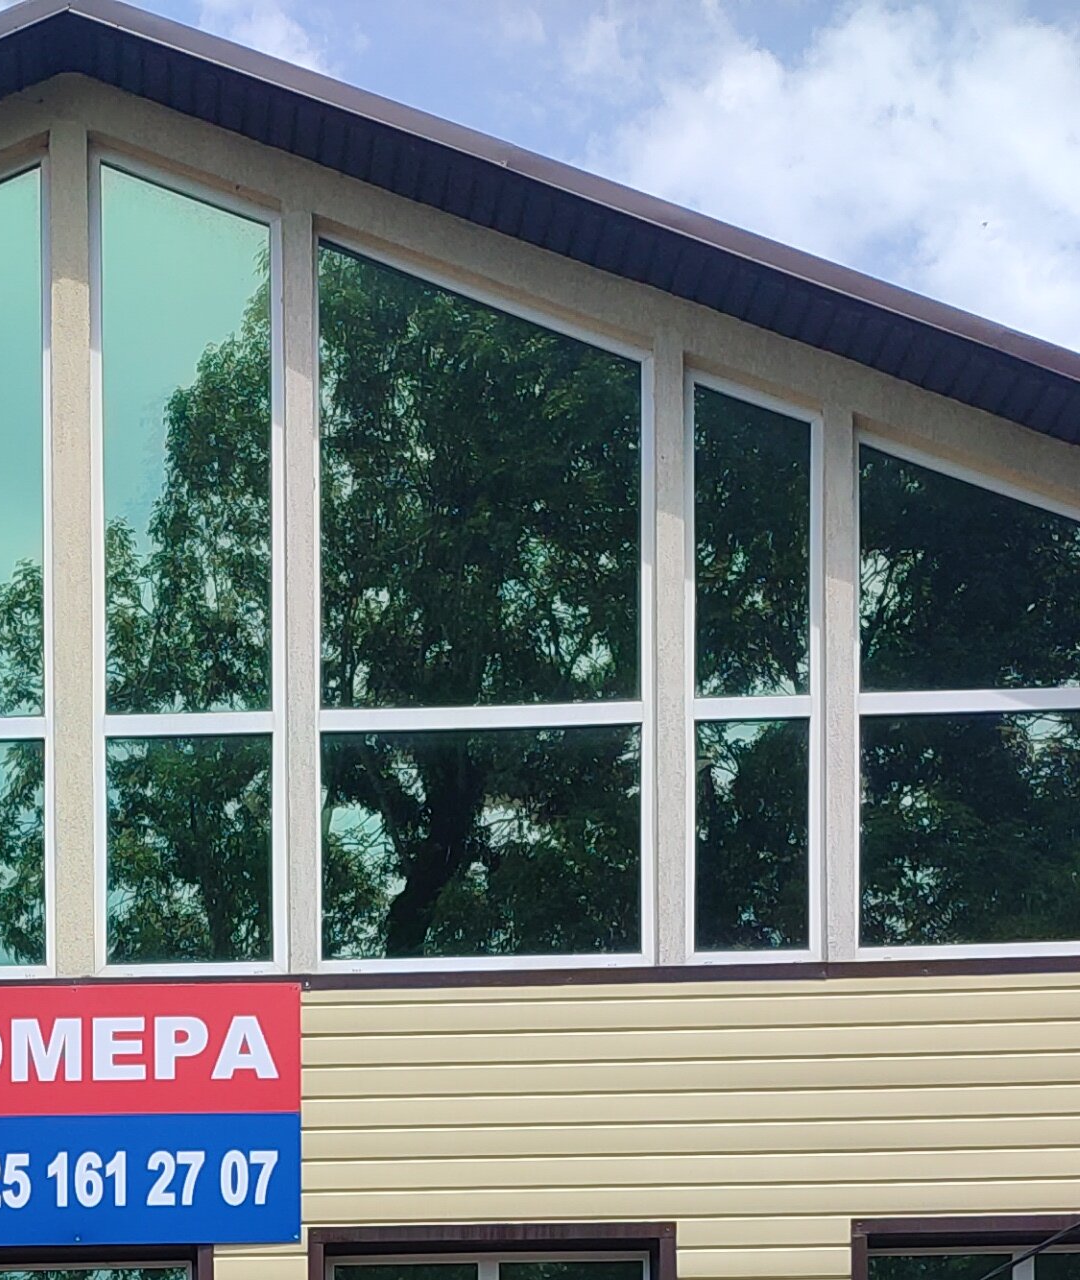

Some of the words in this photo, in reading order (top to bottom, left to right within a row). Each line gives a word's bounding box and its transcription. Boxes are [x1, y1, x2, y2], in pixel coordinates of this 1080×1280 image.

[47, 1151, 127, 1207] 161
[147, 1150, 205, 1206] 27
[220, 1149, 279, 1206] 07
